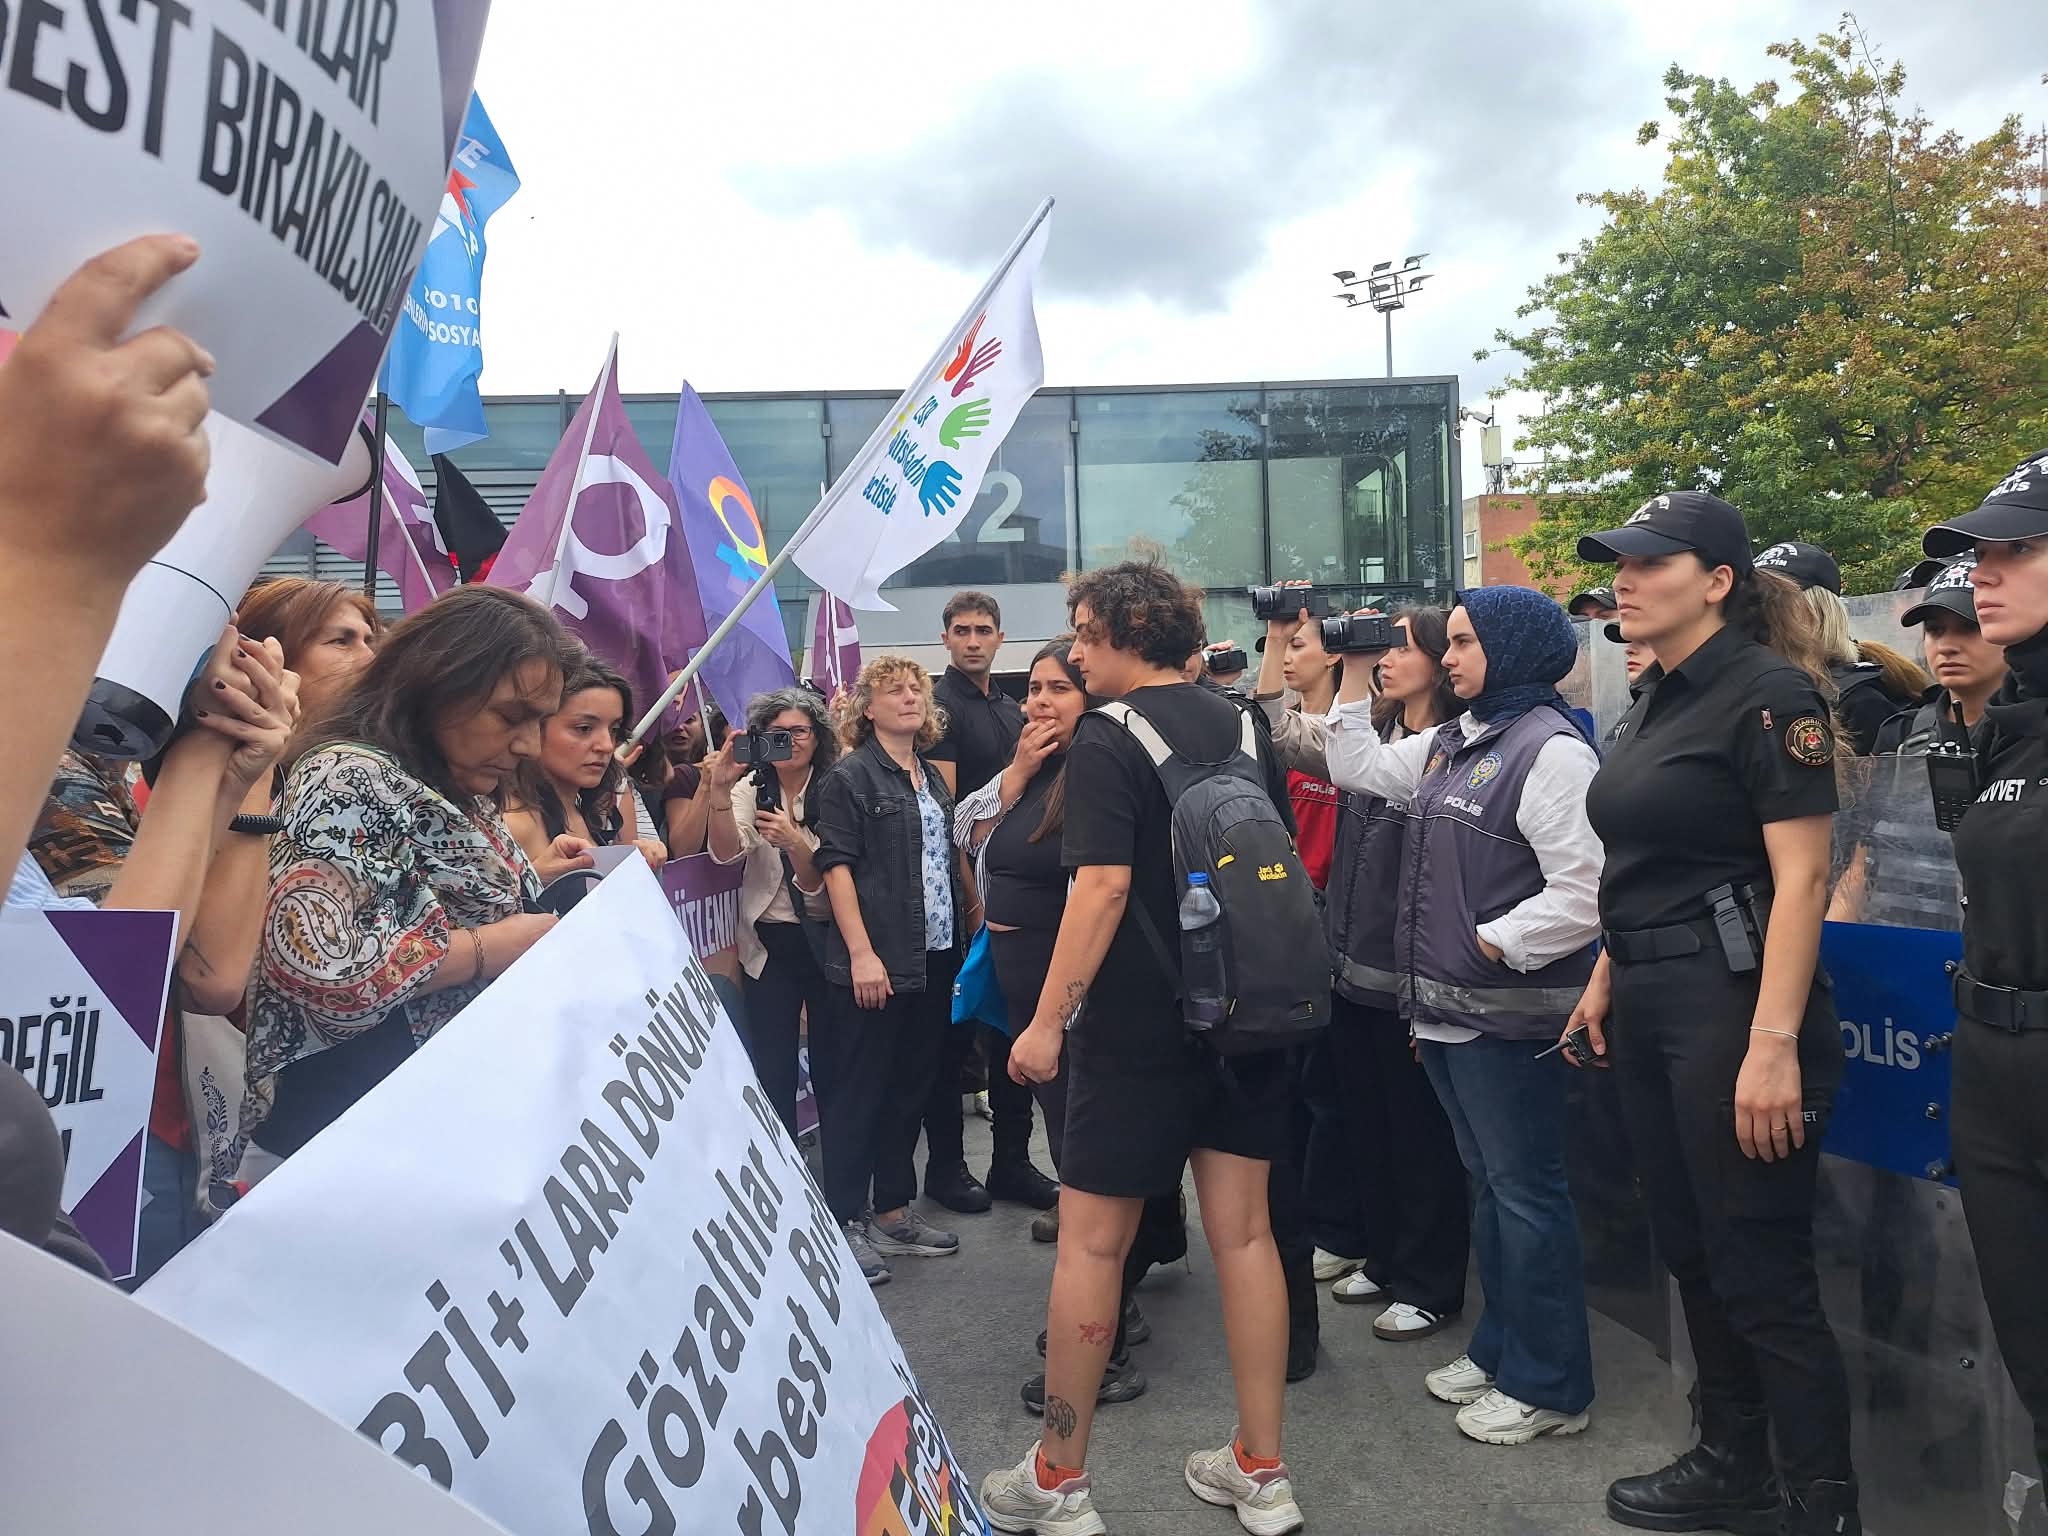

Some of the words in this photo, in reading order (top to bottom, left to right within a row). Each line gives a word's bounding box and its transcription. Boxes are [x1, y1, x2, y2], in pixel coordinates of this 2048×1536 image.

[0, 0, 192, 158] EST
[1302, 781, 1336, 796] POLİS
[1443, 795, 1484, 817] POLİS
[601, 982, 710, 1160] DÖNÜK
[1840, 1017, 1921, 1070] OLİS
[582, 1138, 783, 1536] Gözaltılar
